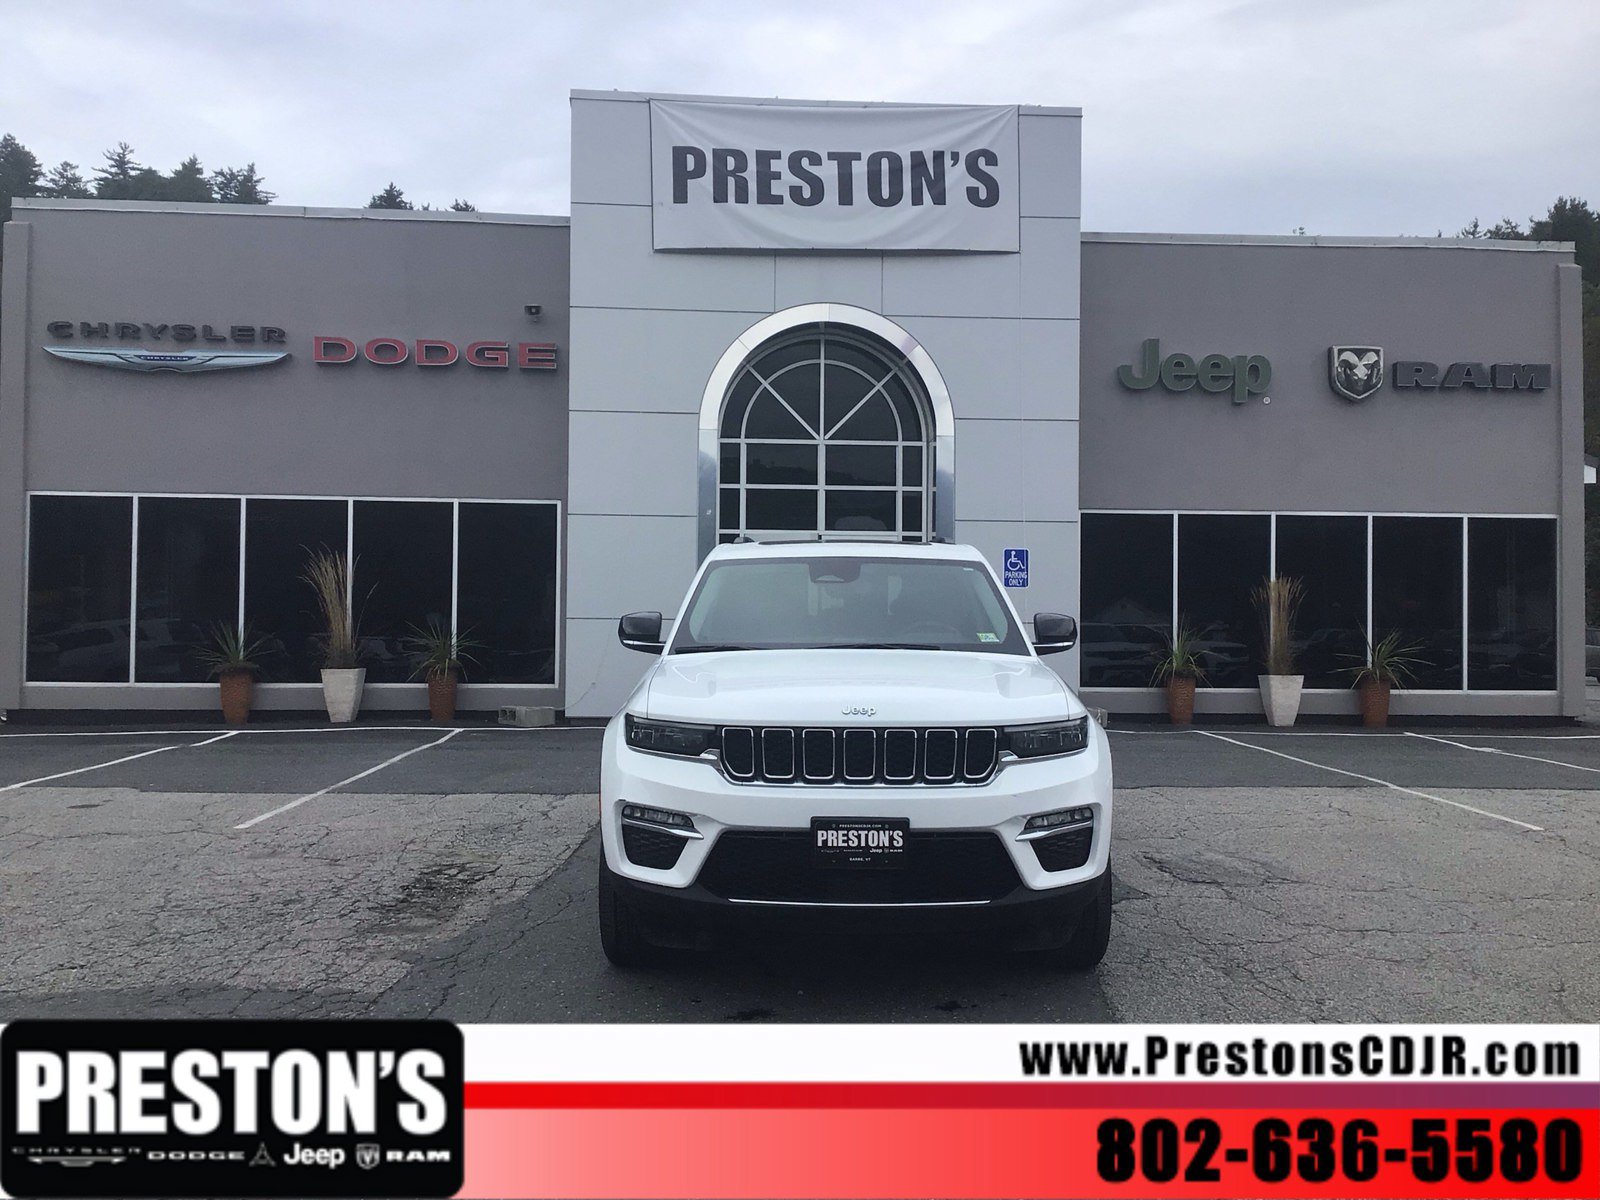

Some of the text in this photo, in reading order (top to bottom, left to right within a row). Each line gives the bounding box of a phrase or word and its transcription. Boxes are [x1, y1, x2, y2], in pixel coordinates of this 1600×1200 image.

[672, 145, 1000, 208] PRESTON'S
[47, 320, 288, 344] CHRYSLER
[313, 336, 558, 370] DODGE
[1118, 338, 1272, 404] Jeep
[1393, 361, 1552, 390] RAM
[1005, 571, 1028, 580] PARKING
[1008, 579, 1024, 587] ONLY
[842, 704, 877, 717] Jeep
[817, 830, 904, 847] PRESTON'S
